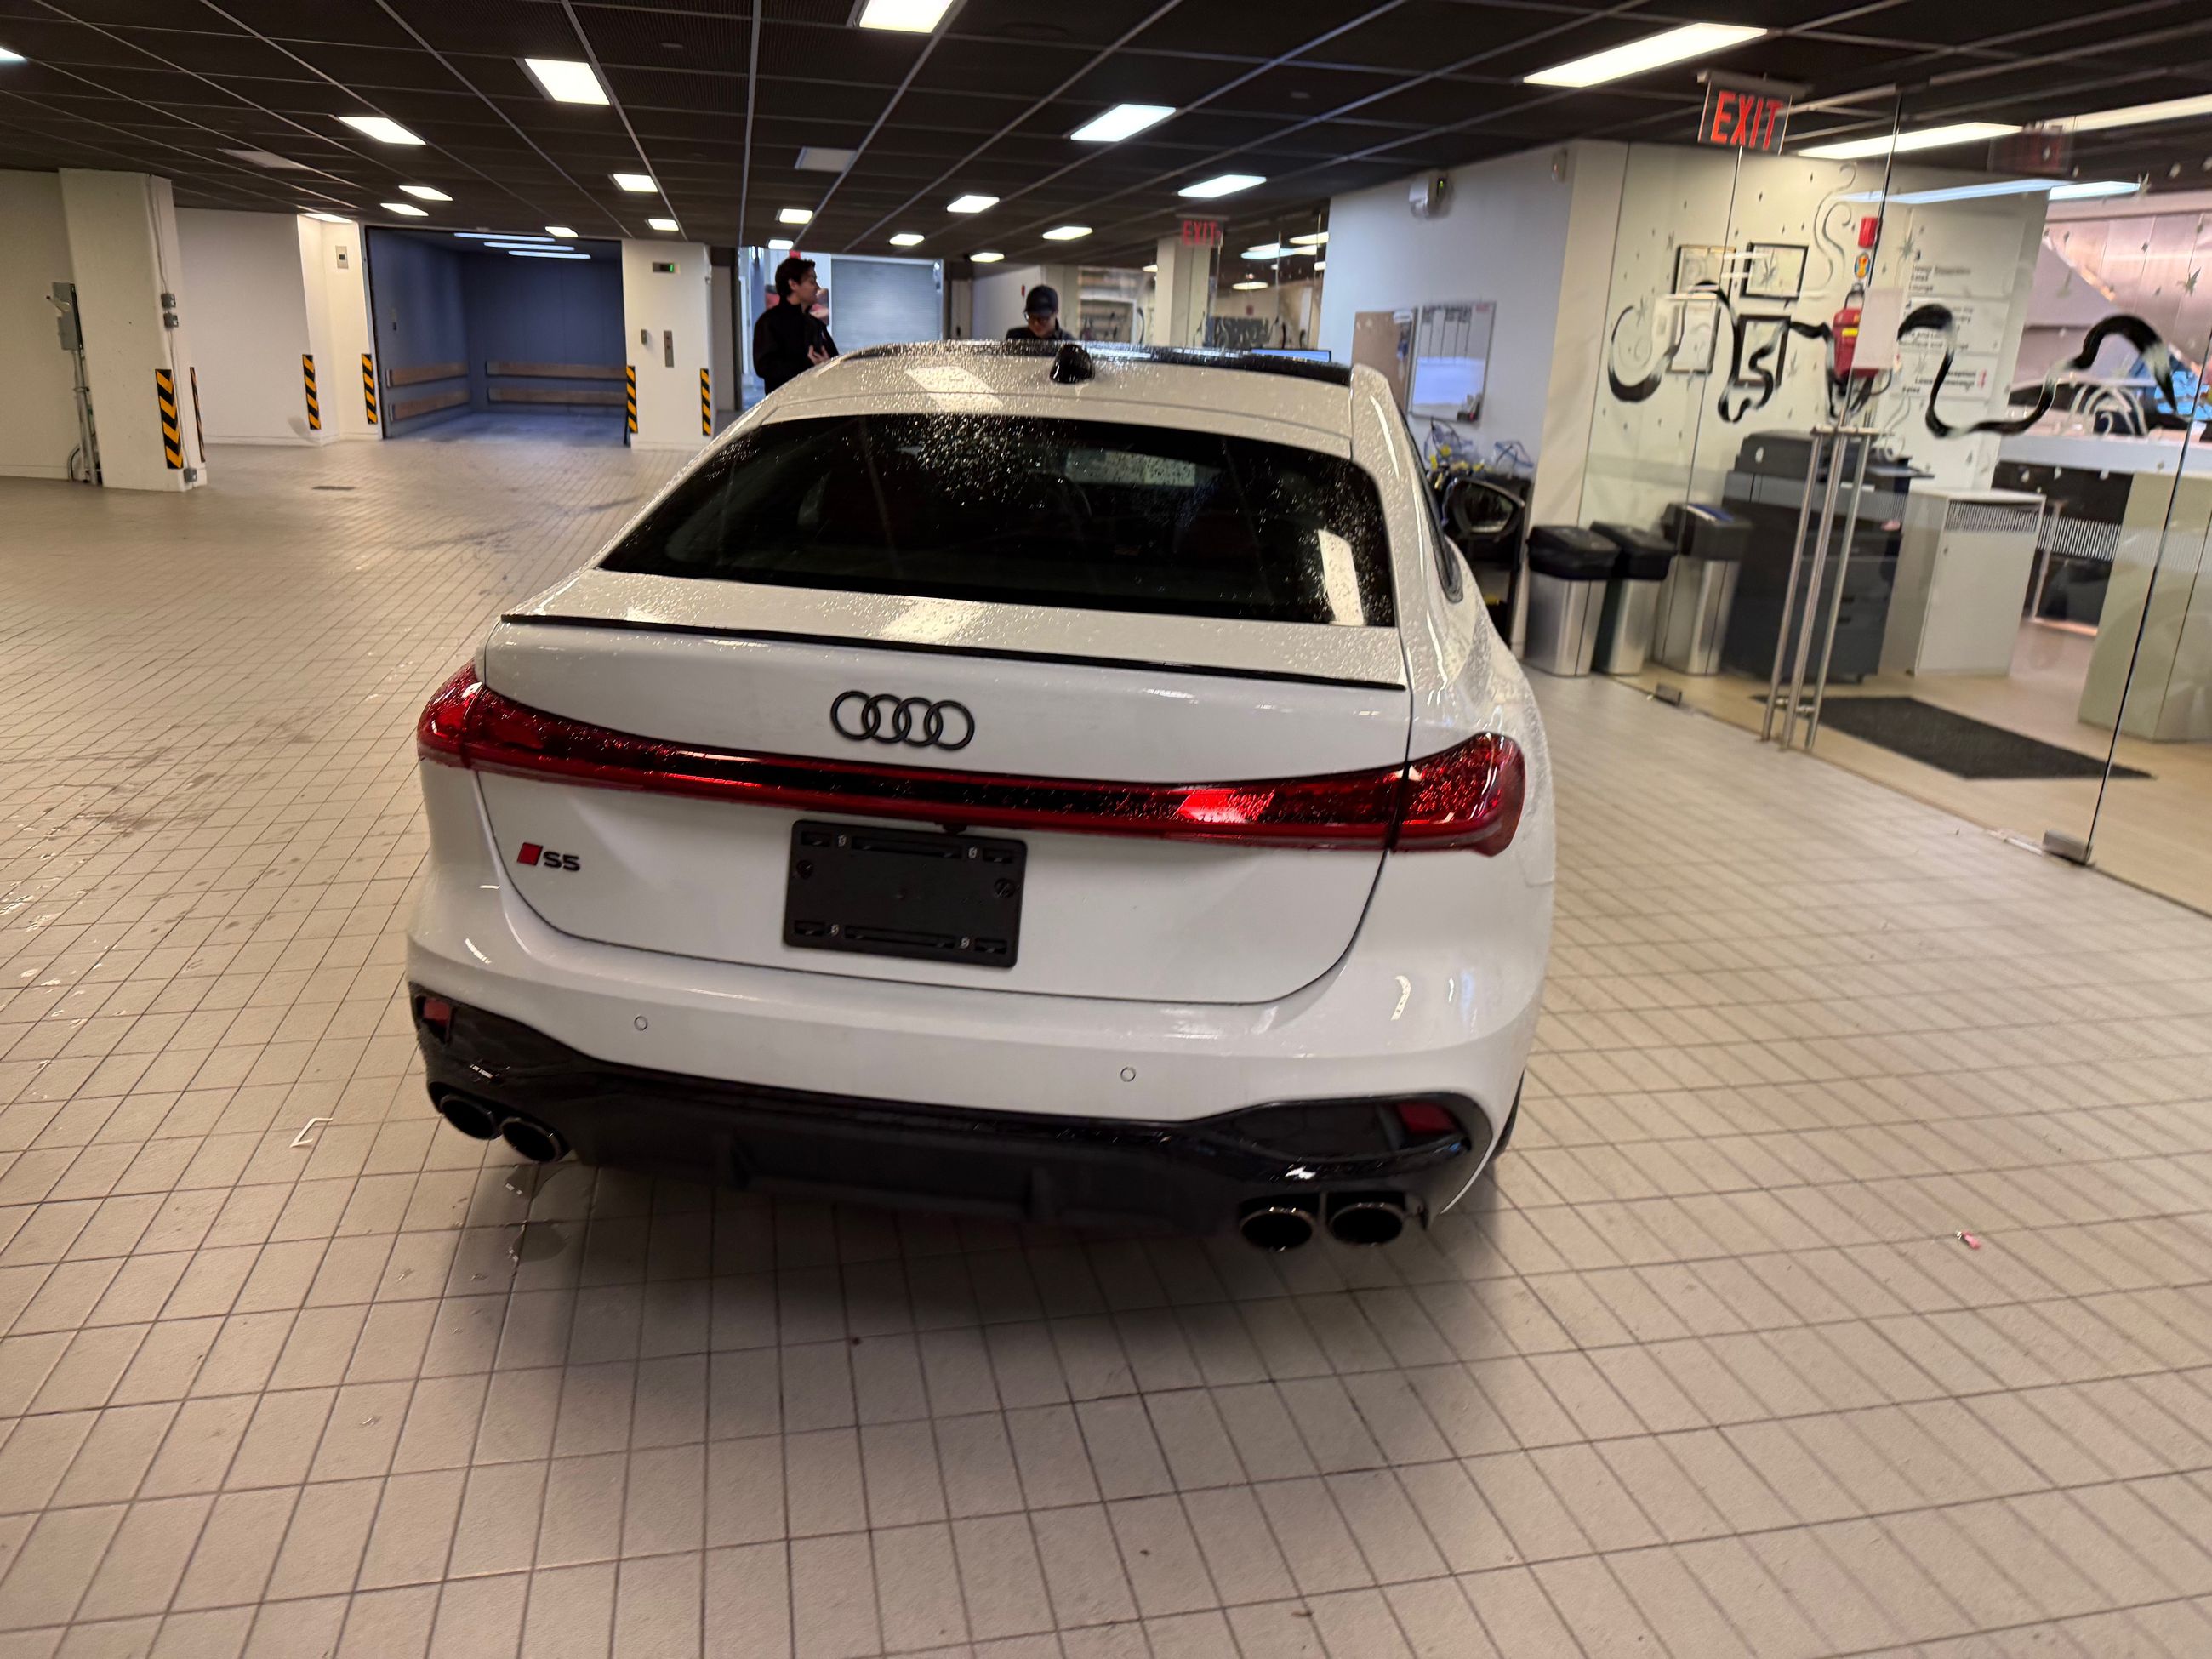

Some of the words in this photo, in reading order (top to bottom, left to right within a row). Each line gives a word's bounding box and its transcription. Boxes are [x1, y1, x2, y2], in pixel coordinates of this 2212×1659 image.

[1710, 90, 1784, 151] EXIT
[1183, 219, 1217, 246] EXIT
[543, 851, 580, 872] S5
